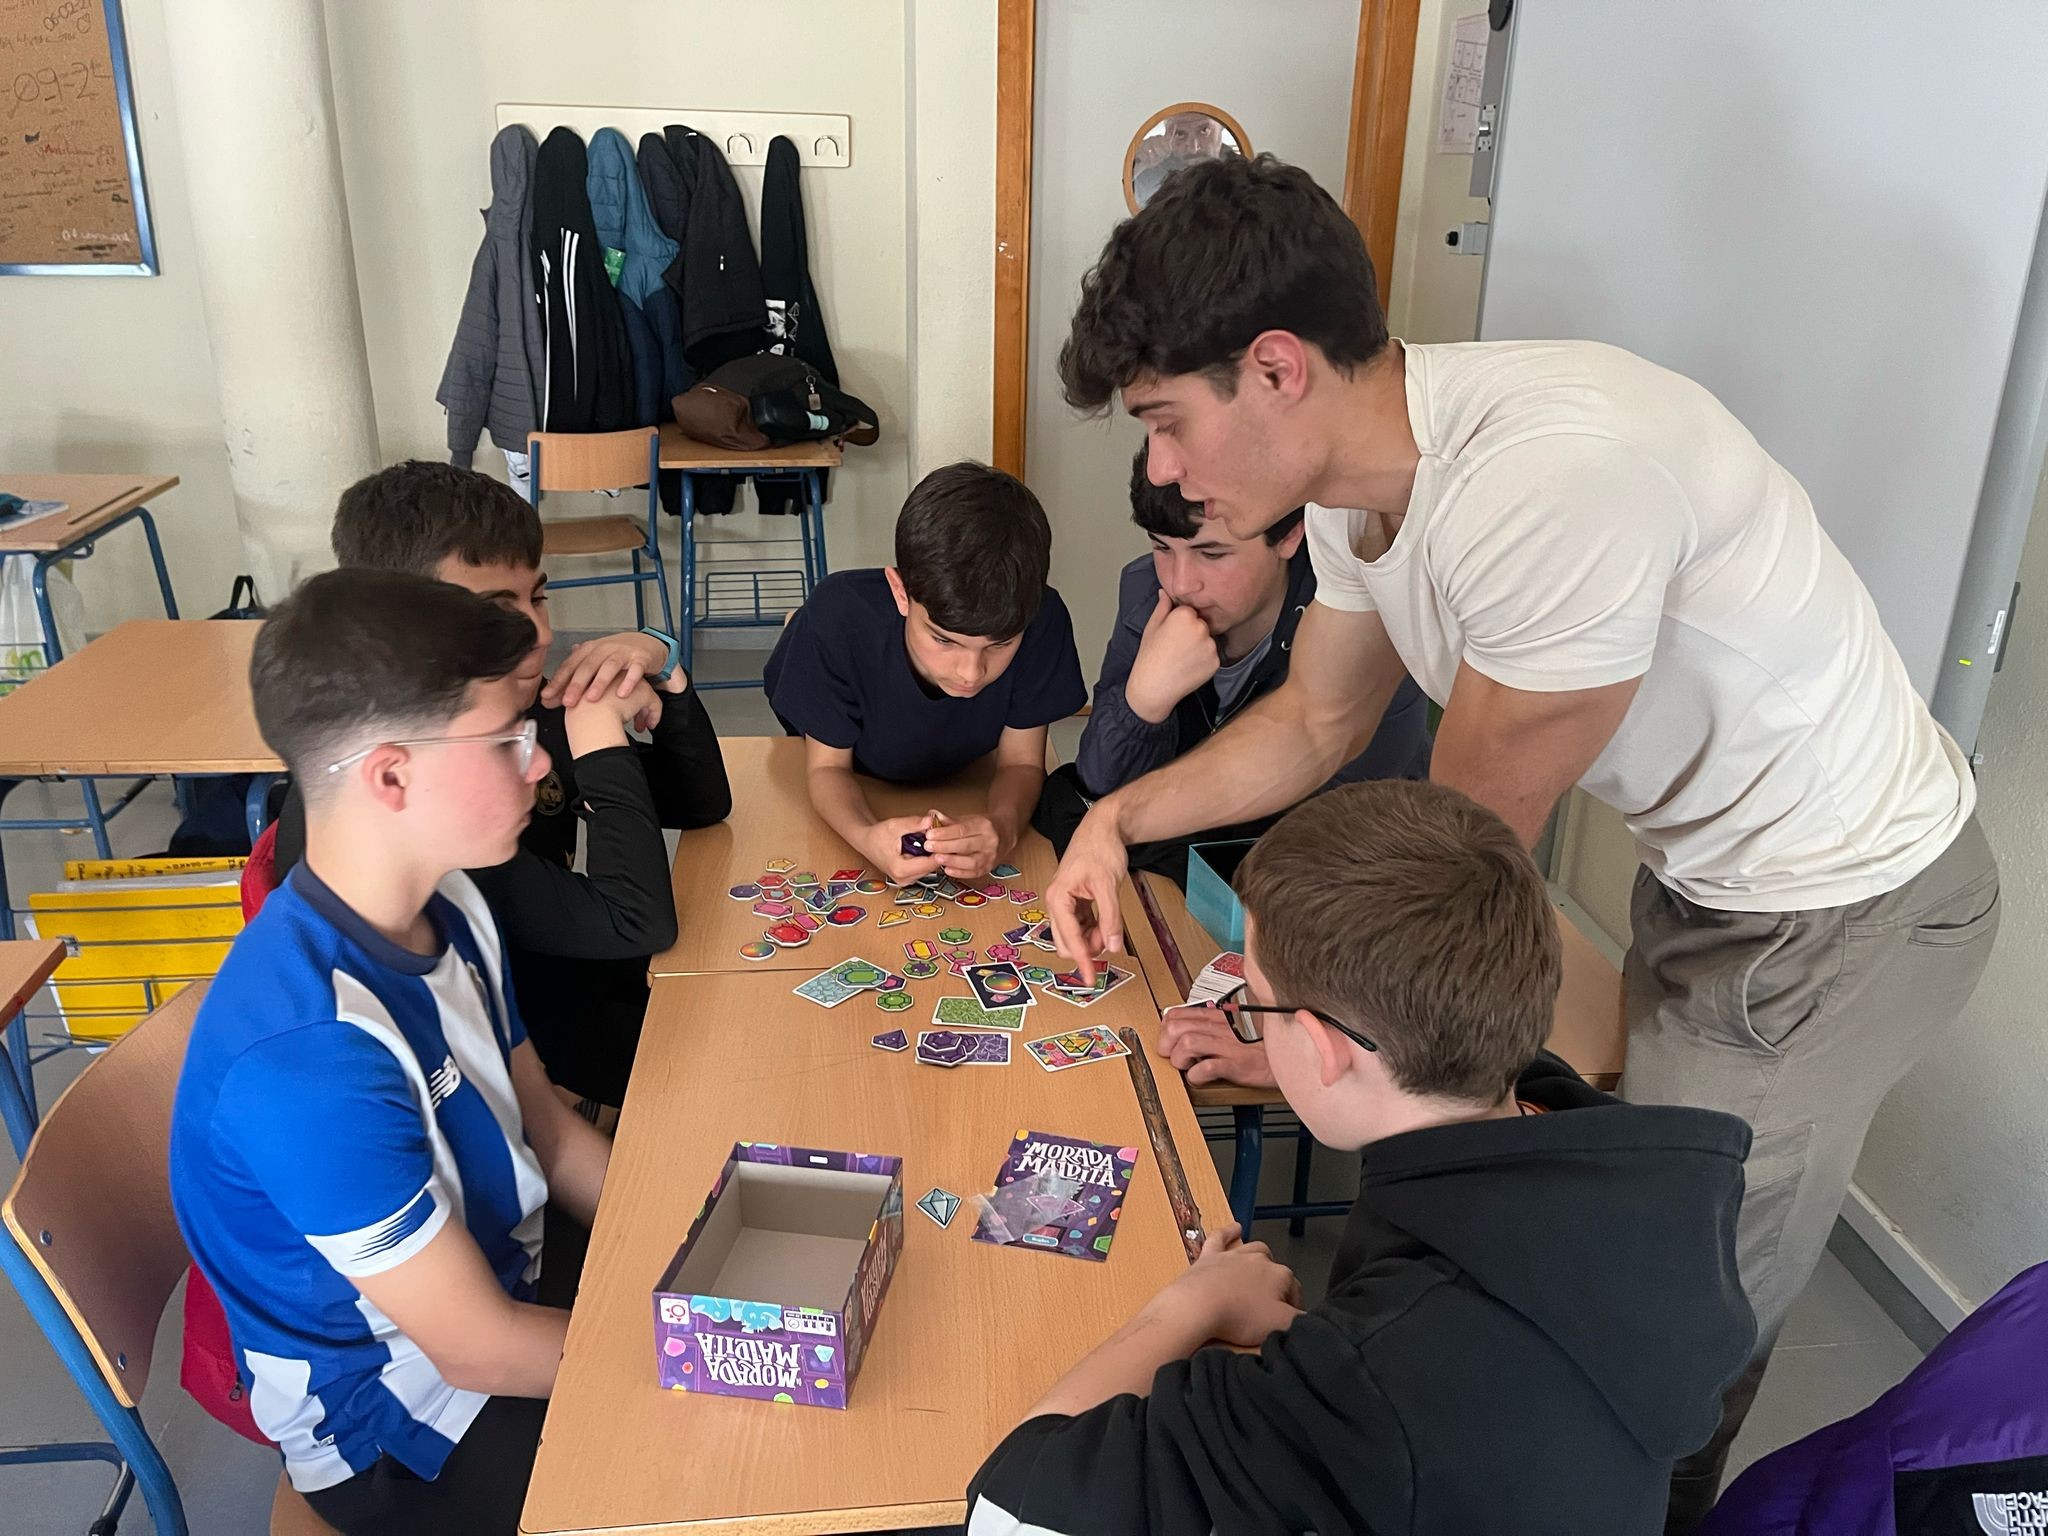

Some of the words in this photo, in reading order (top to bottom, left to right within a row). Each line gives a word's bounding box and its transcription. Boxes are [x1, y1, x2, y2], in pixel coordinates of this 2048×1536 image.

[1014, 1155, 1117, 1188] MALDITA
[1022, 1141, 1114, 1171] MORADA
[694, 1333, 801, 1368] MALDITA
[703, 1357, 801, 1388] MORADA
